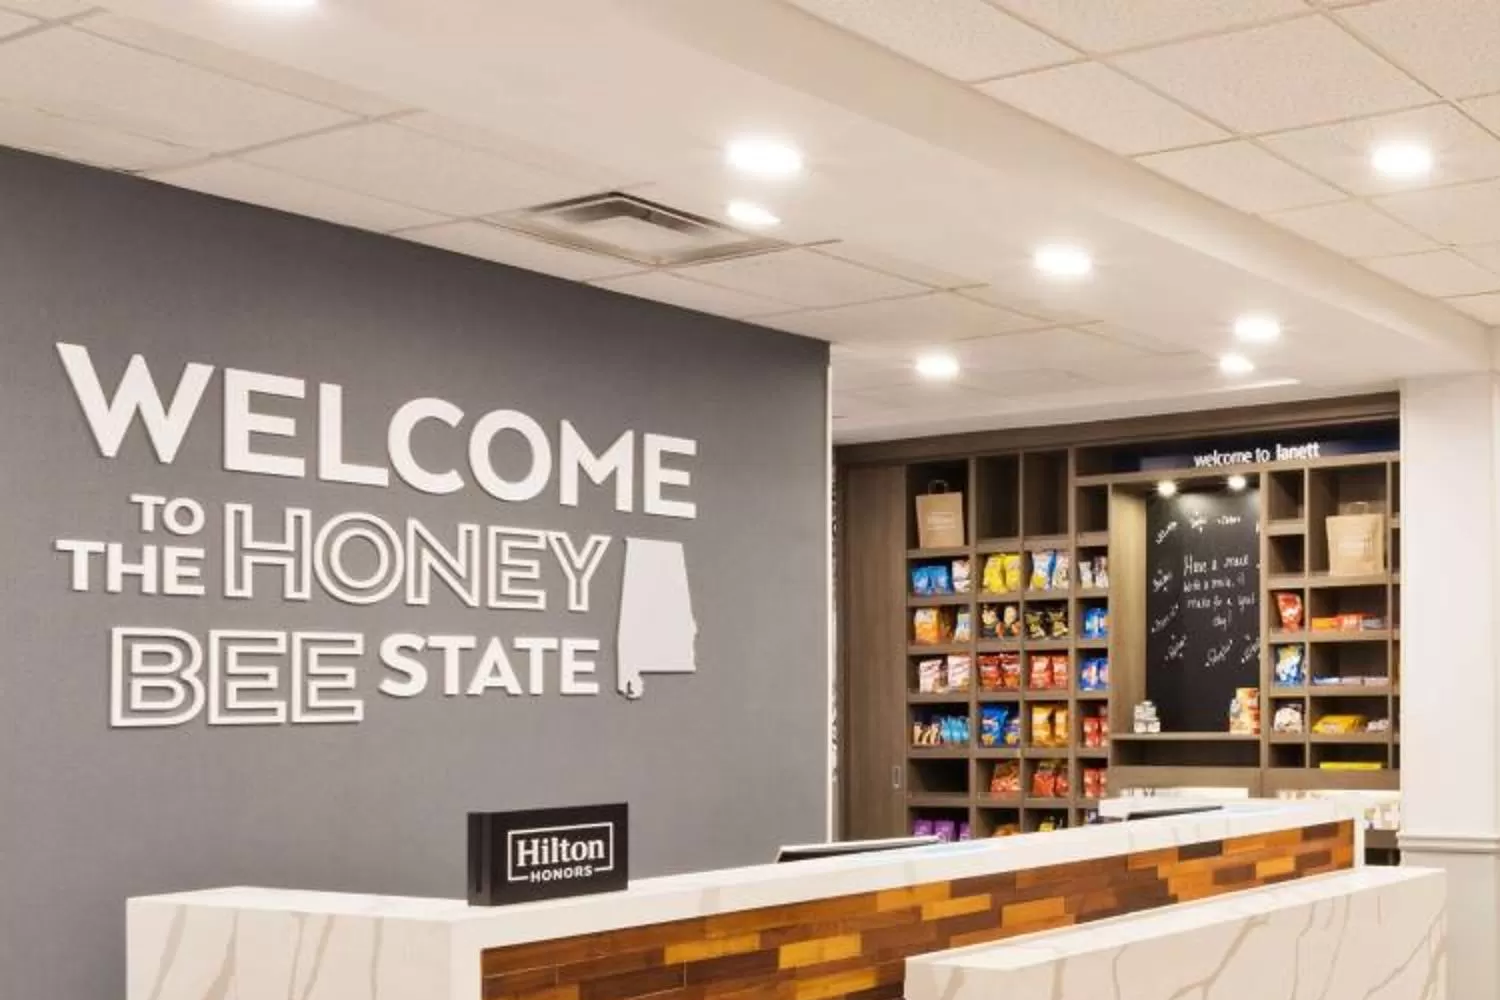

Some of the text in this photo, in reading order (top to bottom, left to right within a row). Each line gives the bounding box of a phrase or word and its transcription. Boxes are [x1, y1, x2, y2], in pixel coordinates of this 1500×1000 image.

[55, 341, 697, 519] WELCOME
[1193, 441, 1320, 468] welcome to lanett
[130, 494, 205, 536] TO
[55, 502, 611, 612] THE HONEY
[110, 626, 600, 729] BEE STATE
[516, 836, 605, 867] Hilton
[530, 865, 593, 883] HONORS
